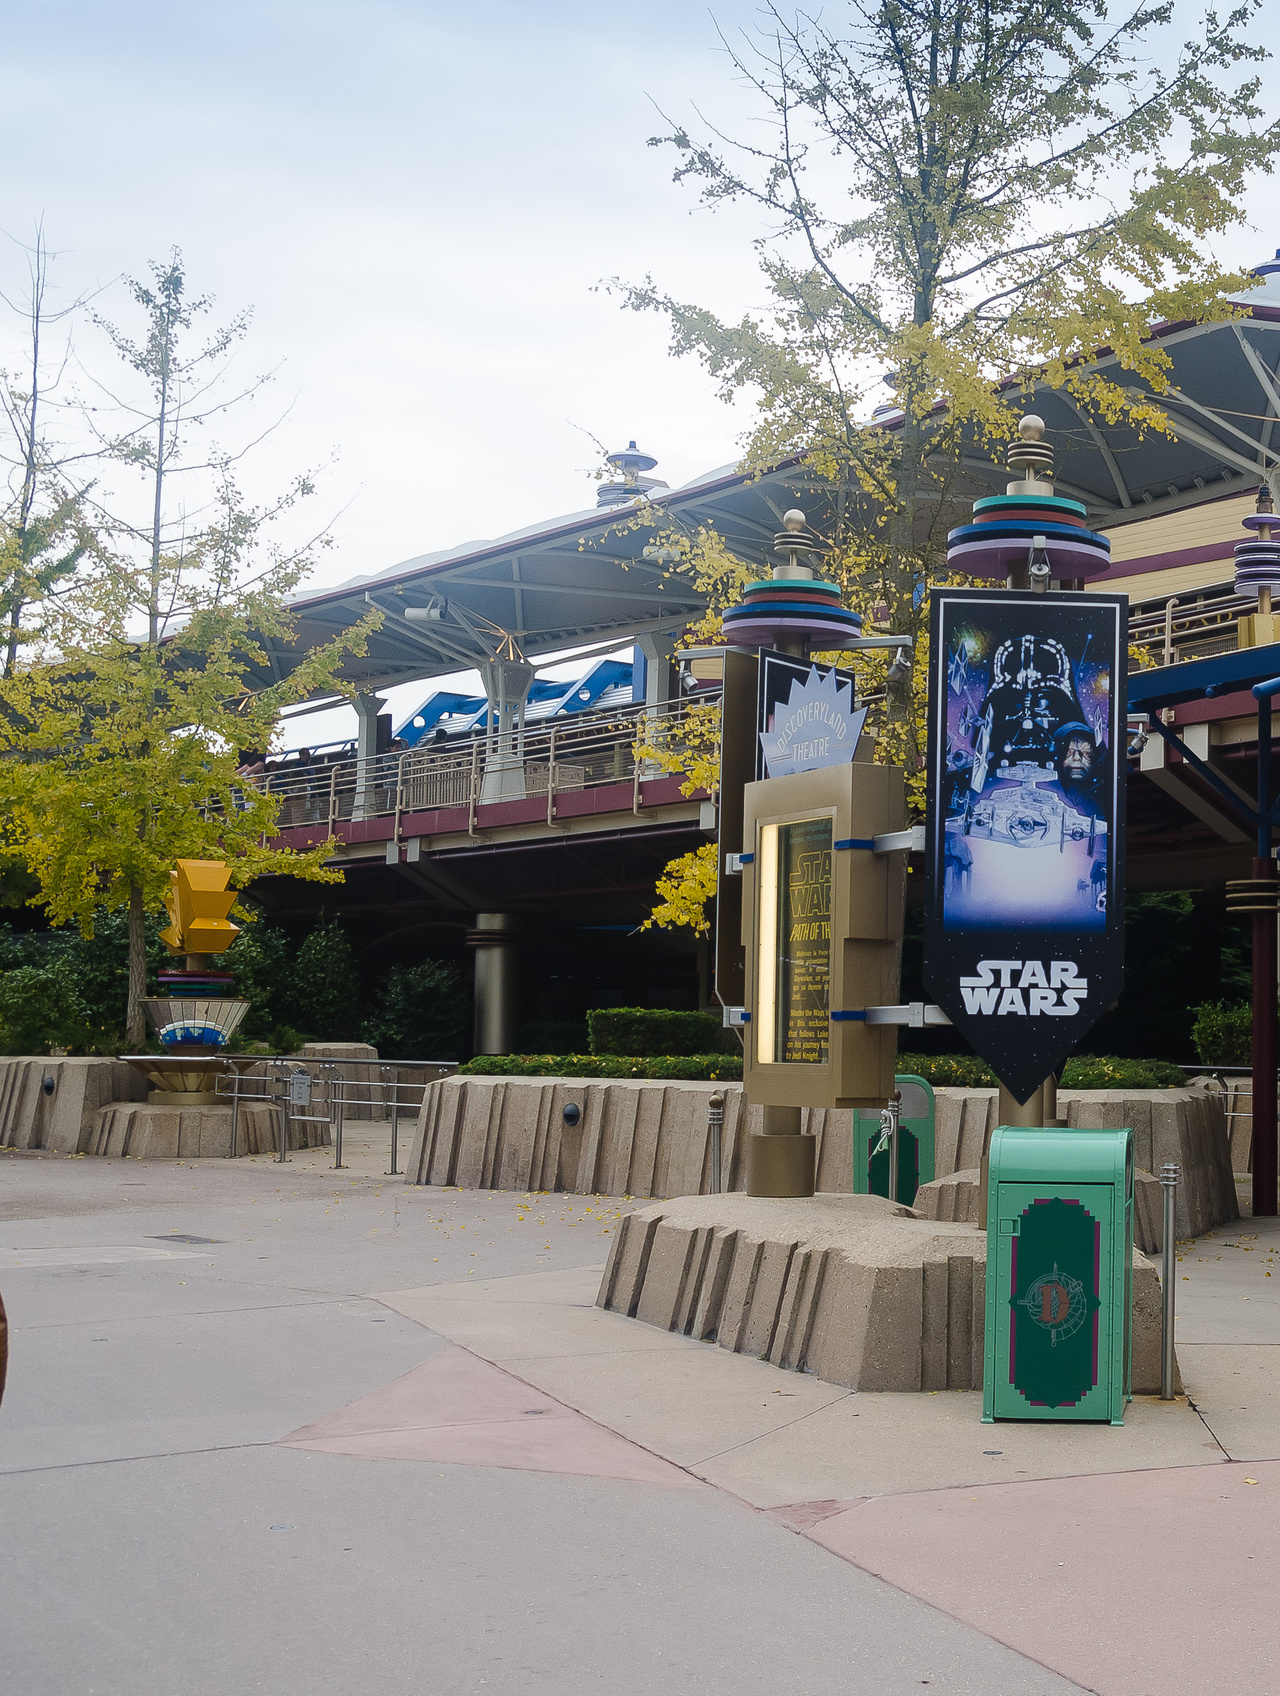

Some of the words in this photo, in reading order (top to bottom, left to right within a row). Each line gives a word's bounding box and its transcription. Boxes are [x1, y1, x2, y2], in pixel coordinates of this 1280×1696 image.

[776, 702, 847, 753] DISCOVERYLAND
[791, 737, 830, 763] THEATRE
[789, 850, 832, 886] STA
[789, 923, 811, 942] PATH
[810, 922, 820, 941] OF
[820, 921, 831, 940] TH
[959, 960, 1088, 988] STAR
[790, 1008, 804, 1016] Master
[813, 1008, 824, 1018] Ways
[959, 988, 1088, 1016] WARS
[788, 1030, 798, 1038] that
[799, 1030, 814, 1038] follows
[817, 1030, 828, 1038] Luke
[796, 1018, 806, 1027] this
[808, 1018, 828, 1027] exclusive
[786, 1052, 792, 1060] to
[792, 1052, 802, 1060] Jedi
[802, 1042, 820, 1050] journey
[820, 1039, 830, 1048] fro
[1037, 1280, 1070, 1325] D
